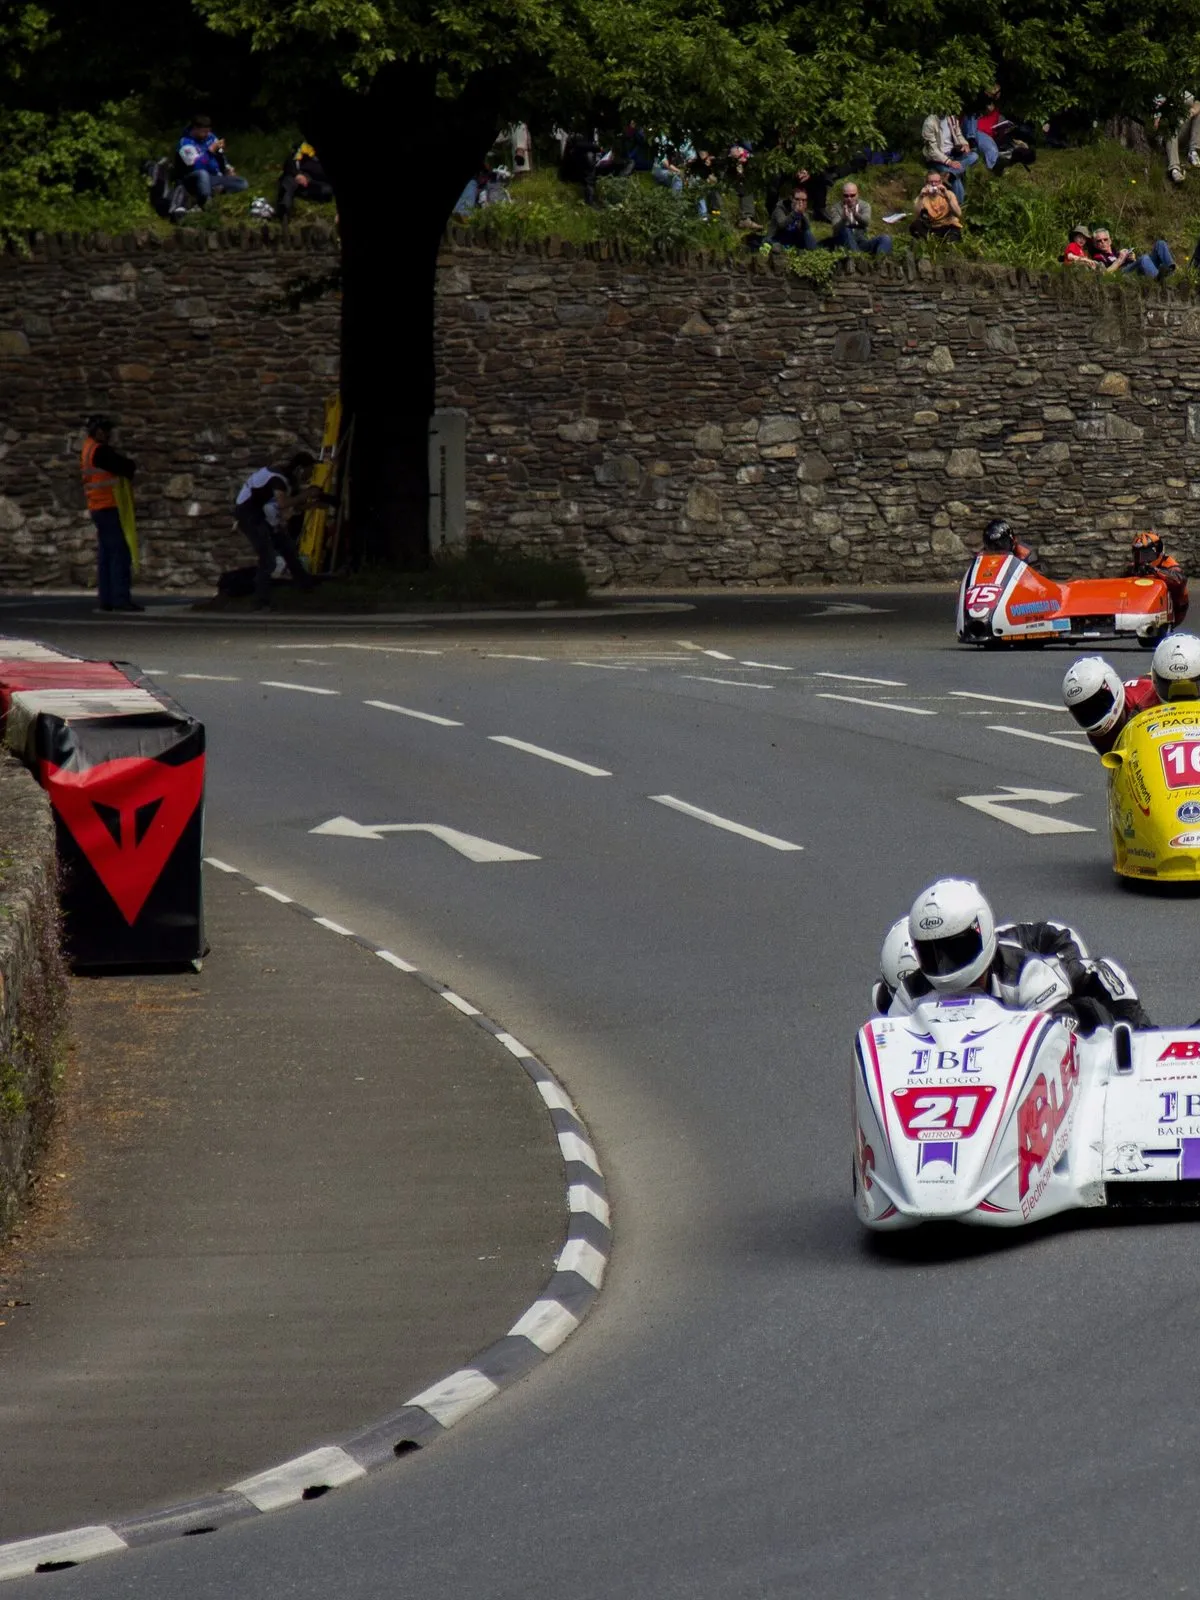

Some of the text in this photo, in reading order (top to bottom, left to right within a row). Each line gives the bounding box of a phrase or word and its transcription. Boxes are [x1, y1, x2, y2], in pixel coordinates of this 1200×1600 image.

[923, 917, 942, 928] Arai
[907, 1076, 982, 1085] BAR LOGO
[908, 1095, 979, 1129] 21
[921, 1131, 957, 1139] NITRON
[1157, 1127, 1184, 1136] BAR
